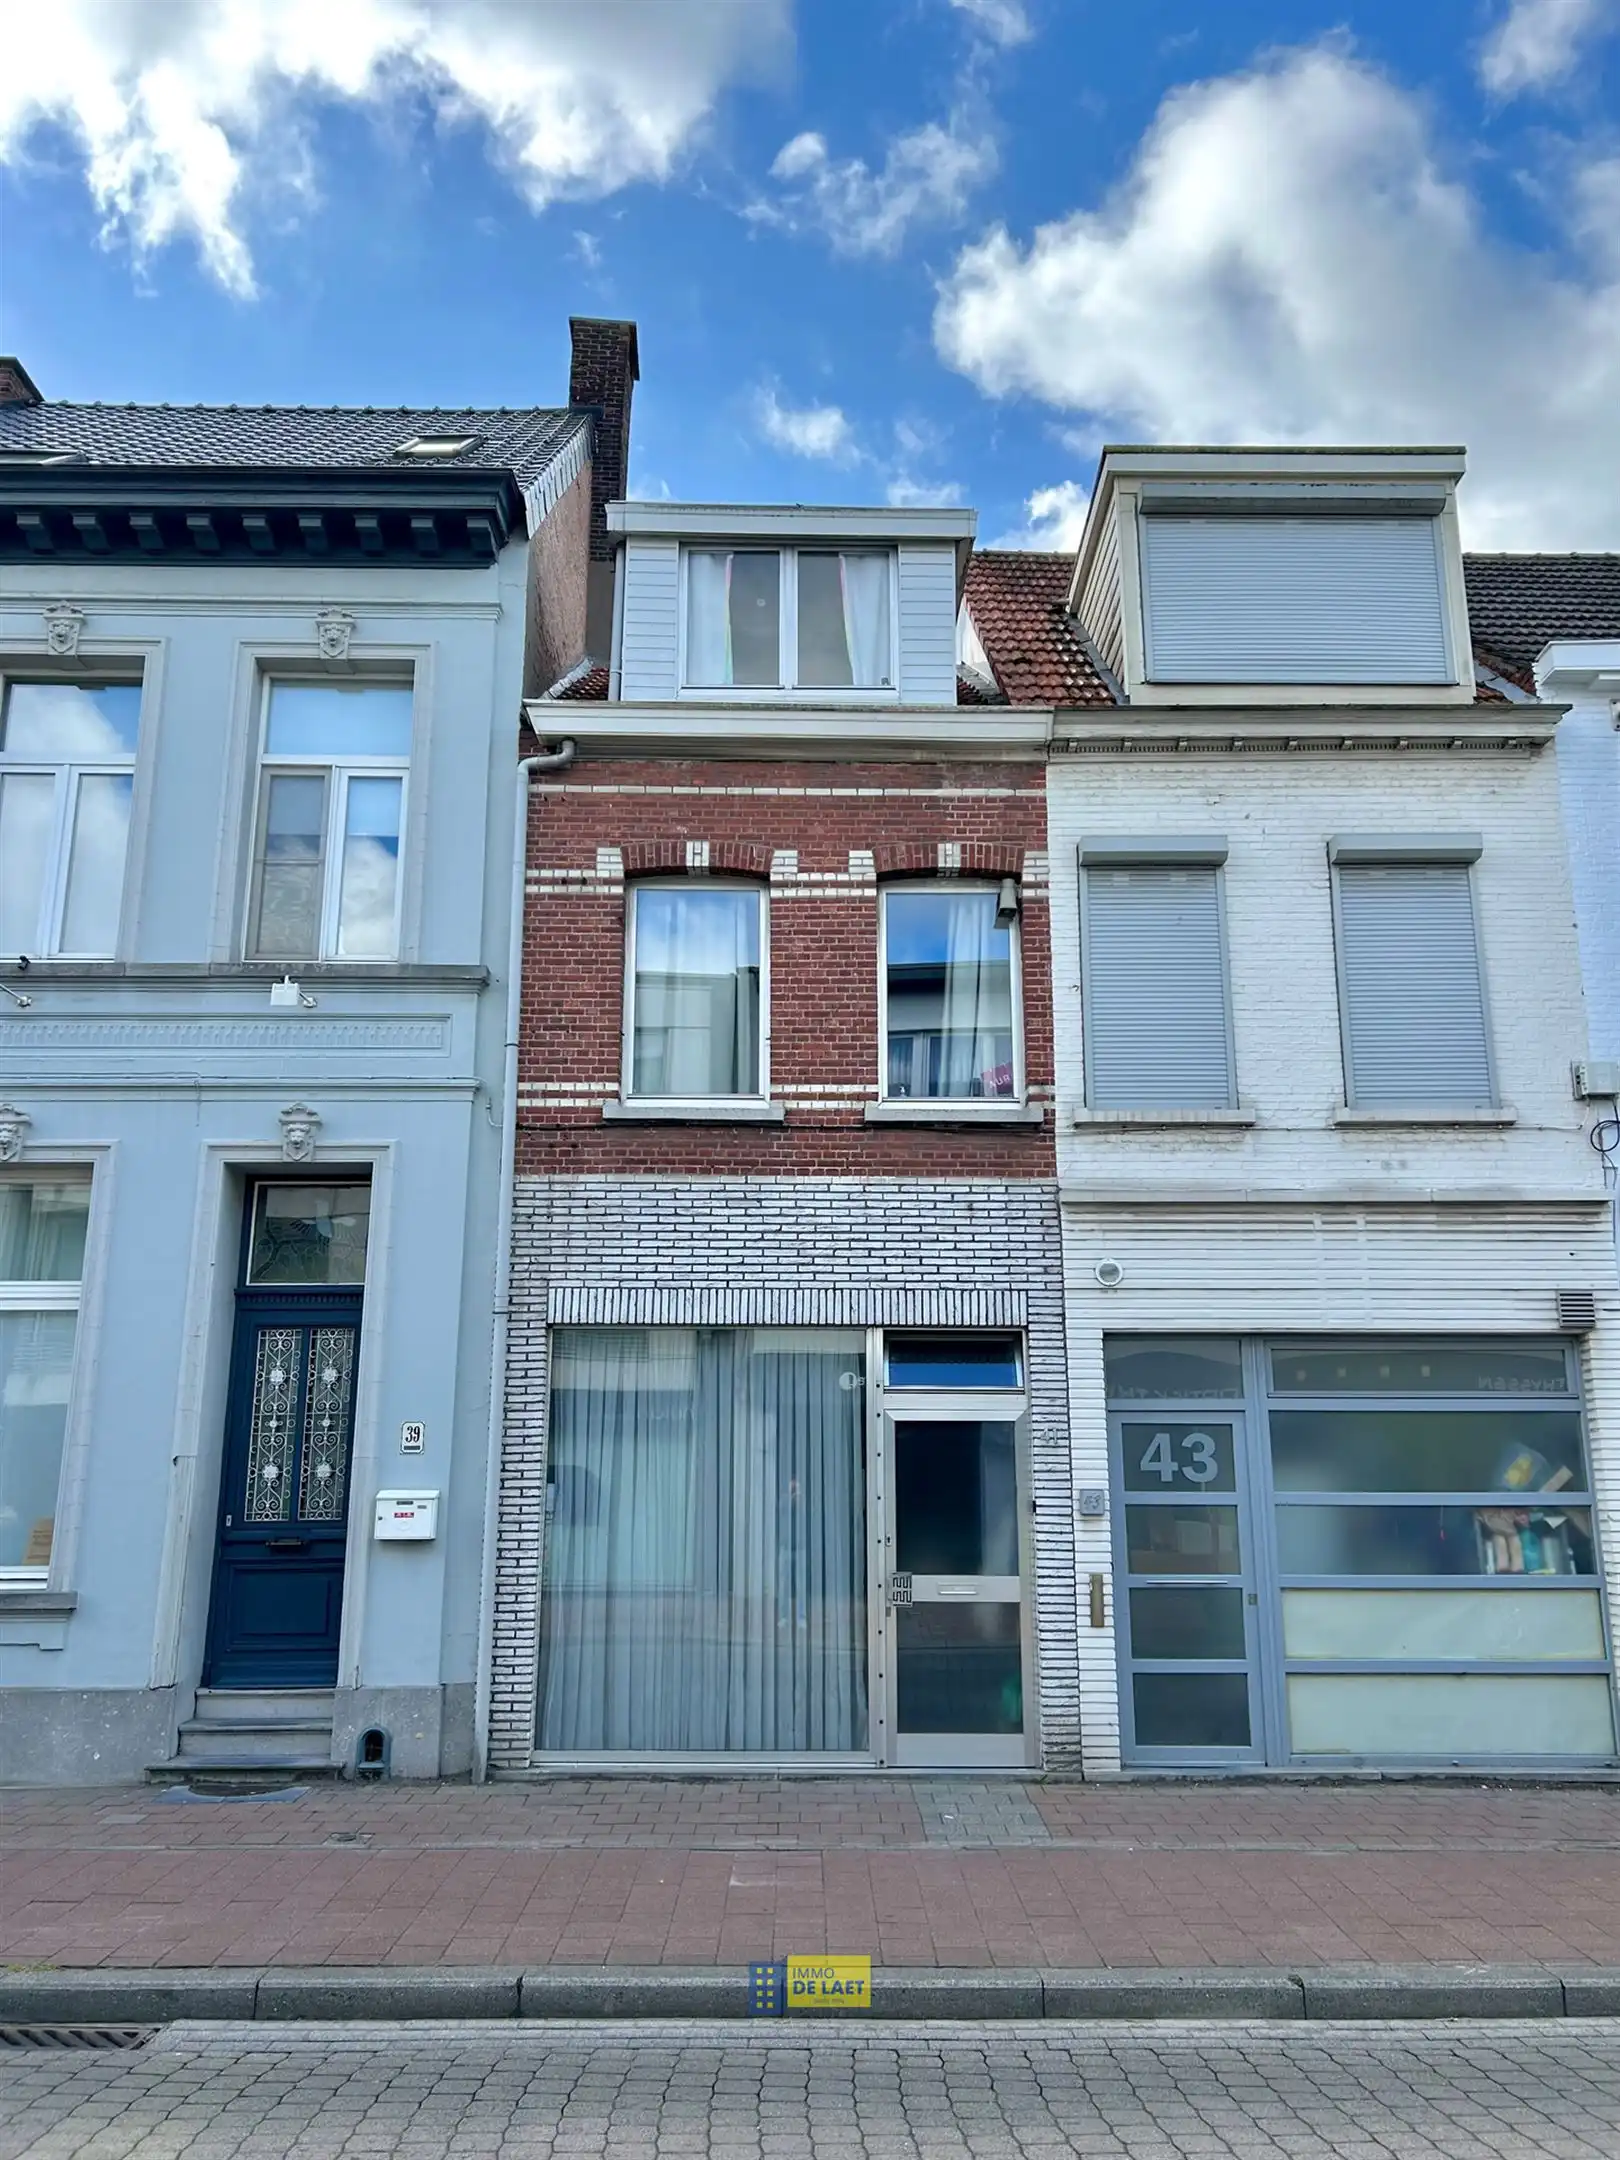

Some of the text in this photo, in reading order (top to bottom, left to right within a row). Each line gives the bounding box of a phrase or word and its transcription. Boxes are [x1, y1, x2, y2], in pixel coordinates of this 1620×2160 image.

[405, 1425, 421, 1443] 39
[1040, 1428, 1058, 1445] 41
[1140, 1433, 1218, 1483] 43
